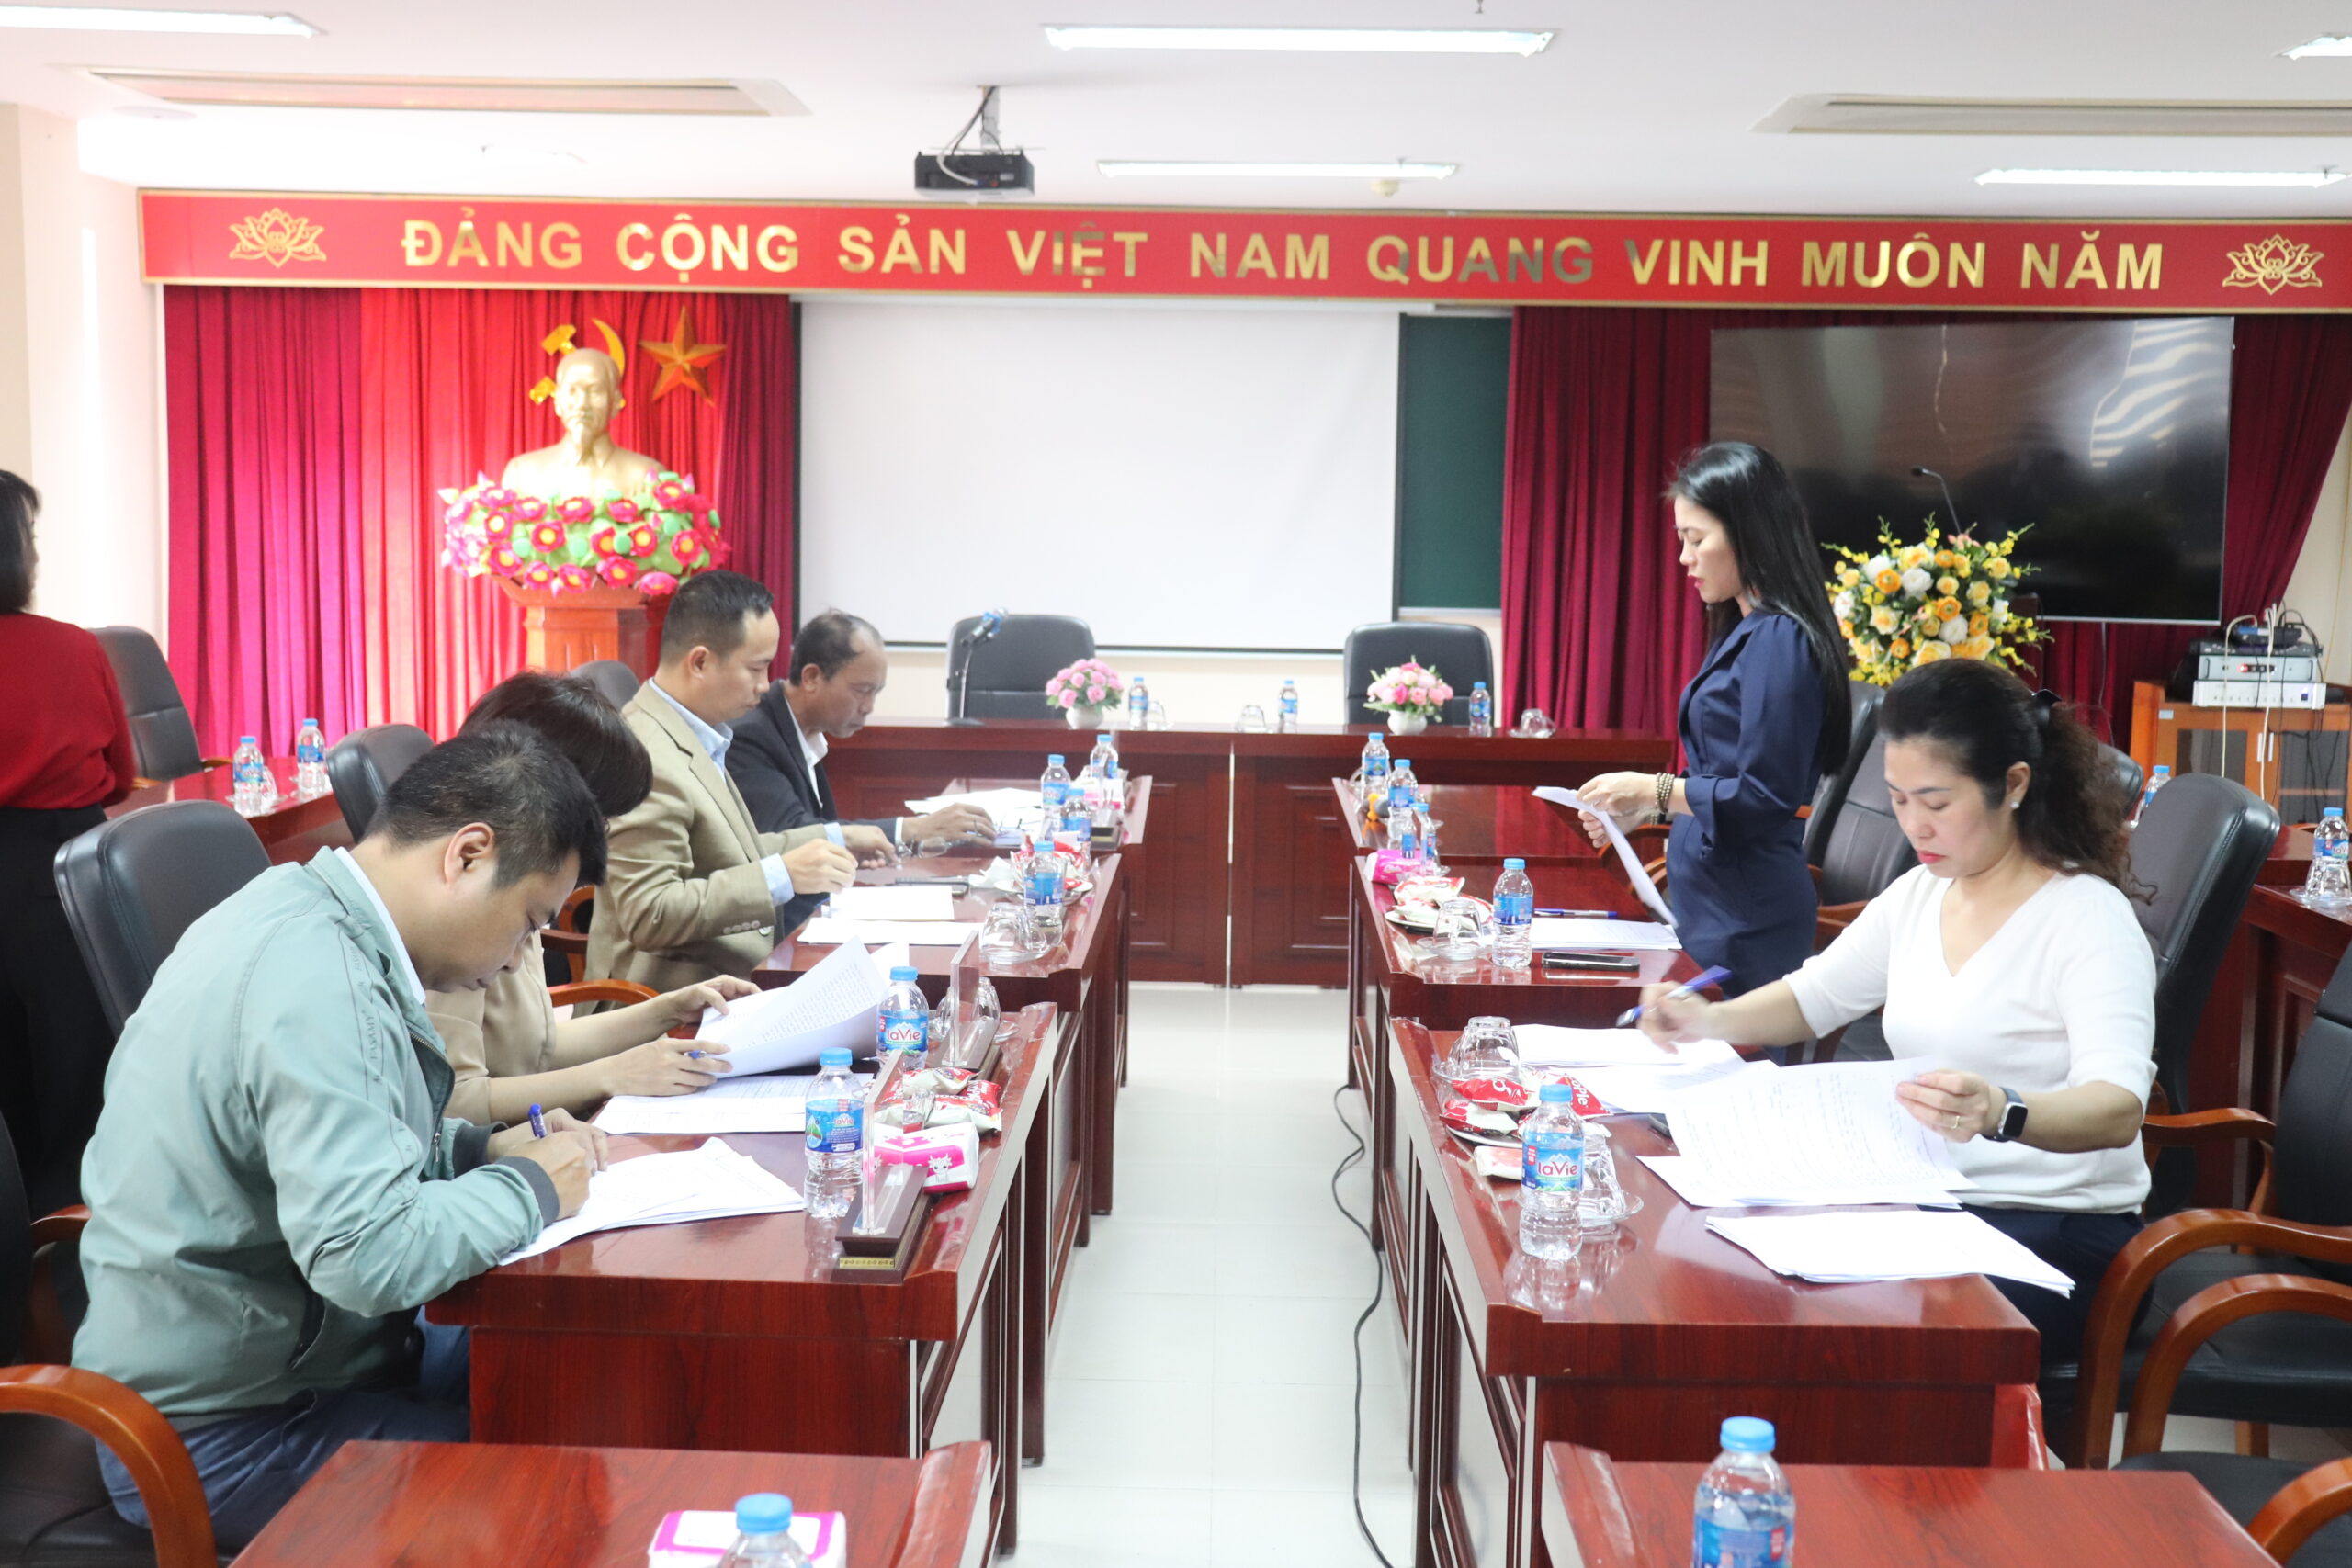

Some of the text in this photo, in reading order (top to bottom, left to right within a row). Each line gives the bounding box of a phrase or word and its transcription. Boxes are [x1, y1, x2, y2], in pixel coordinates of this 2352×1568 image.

[401, 207, 2163, 290] ĐẢNG CỘNG SẢN VIỆT NAM QUANG VINH MUÔN NĂM
[887, 1028, 921, 1041] laVie
[1537, 1160, 1578, 1176] laVie
